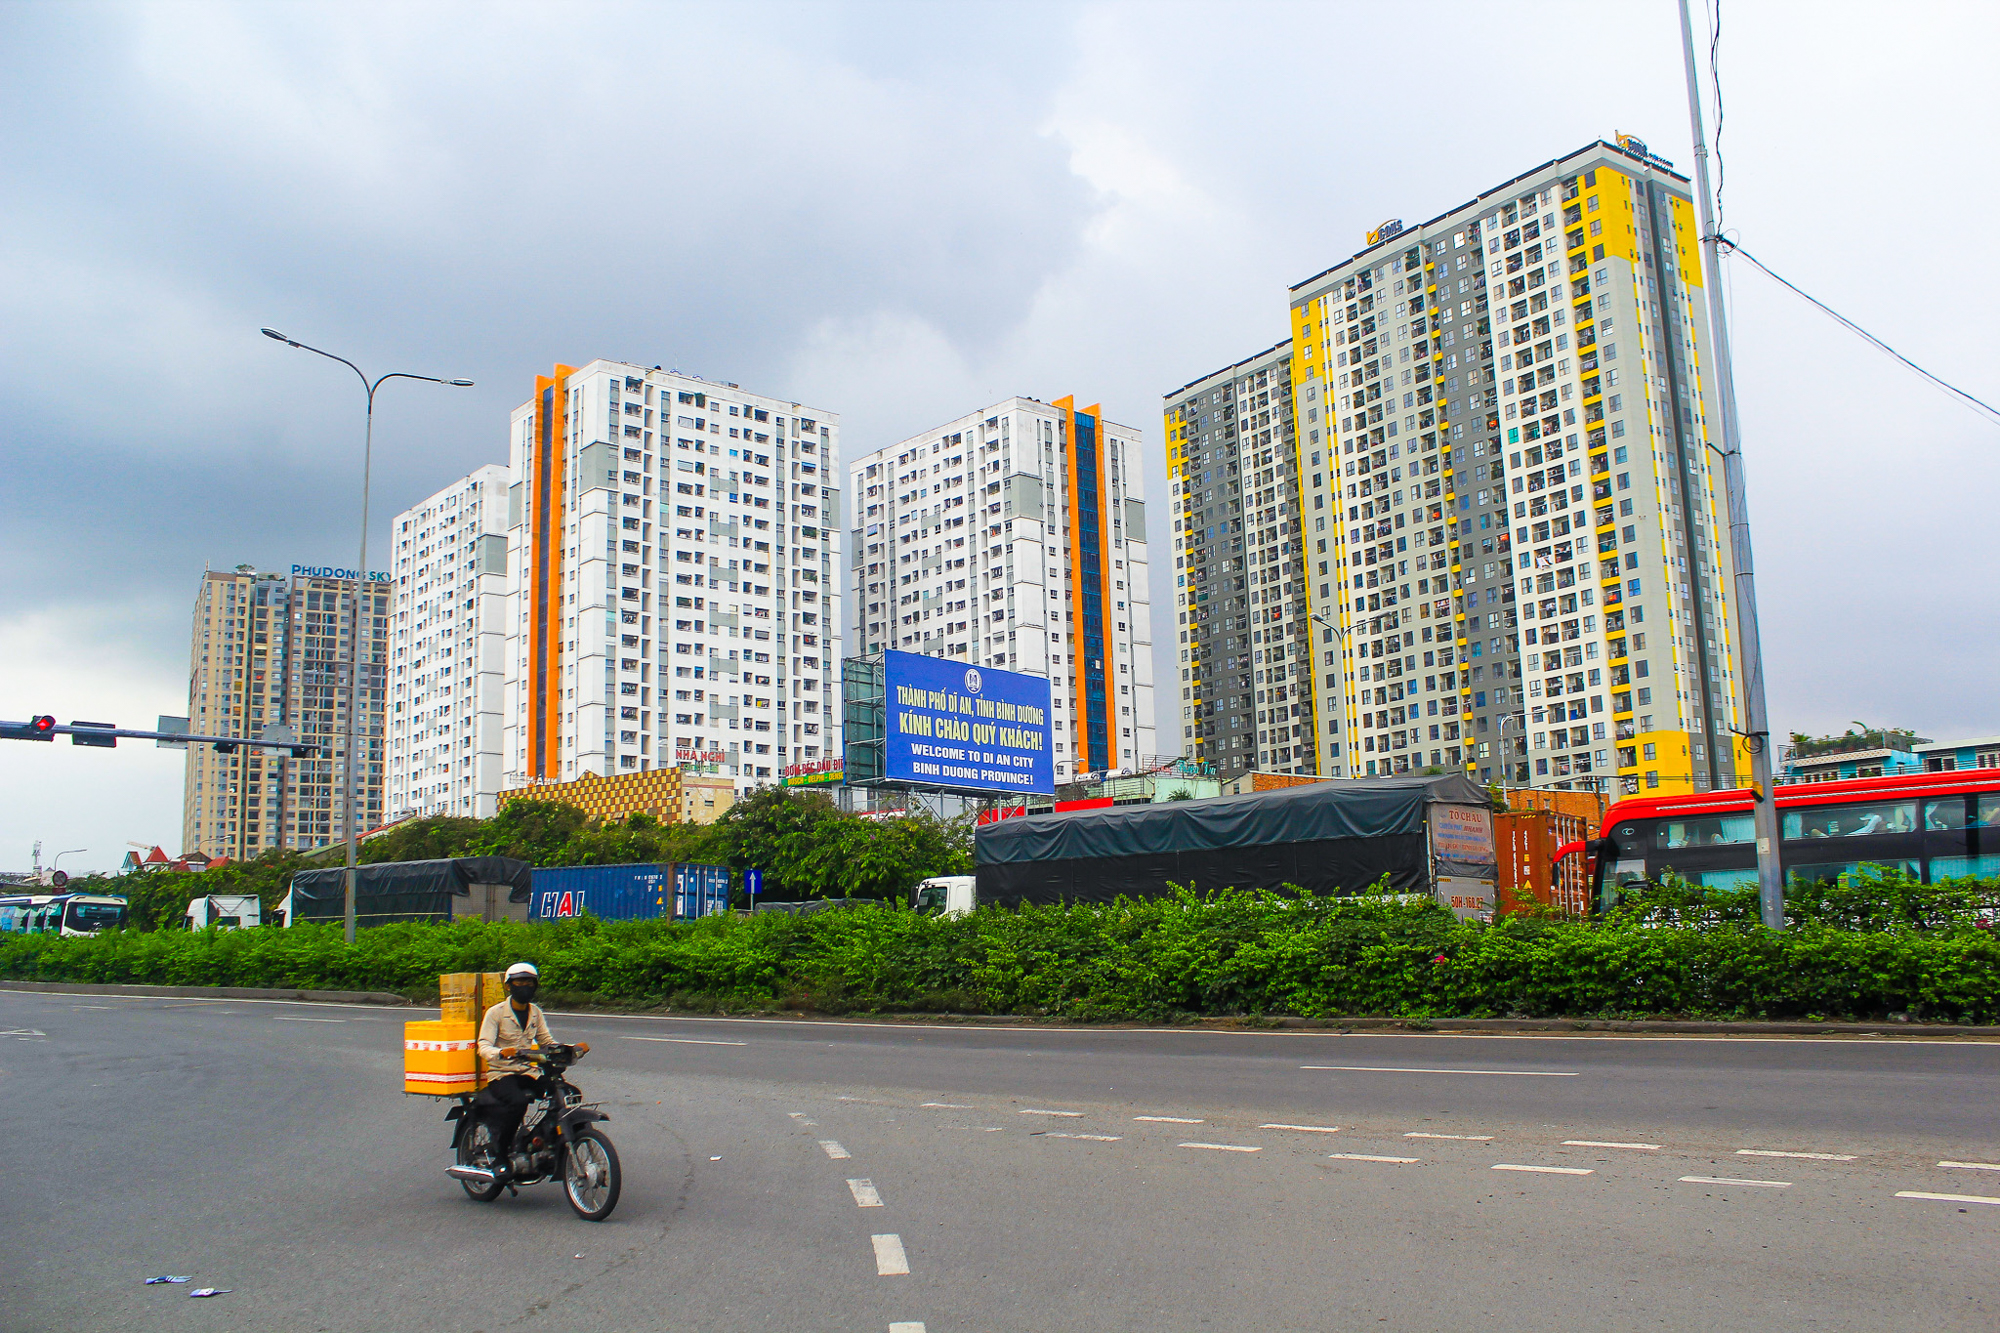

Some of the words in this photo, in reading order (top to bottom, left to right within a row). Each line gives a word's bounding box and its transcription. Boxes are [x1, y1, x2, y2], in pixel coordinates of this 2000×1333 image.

[896, 683, 927, 709] THÀNH
[928, 687, 947, 711] PHỐ
[948, 691, 958, 713] DĨ
[959, 696, 975, 718] AN,
[975, 693, 995, 719] TỈNH
[996, 698, 1016, 722] BÌNH
[1017, 704, 1044, 726] DƯƠNG
[899, 709, 932, 737] KÍNH
[935, 715, 970, 742] CHÀO
[972, 721, 996, 746] QUÝ
[999, 725, 1043, 751] KHÁCH!
[675, 746, 698, 761] NHÀ
[910, 743, 966, 761] WELCOME
[967, 750, 981, 763] TO
[983, 752, 994, 764] DI
[996, 754, 1011, 766] AN
[1013, 756, 1034, 768] CITY
[912, 762, 940, 775] BINH
[942, 765, 979, 780] DUONG
[981, 769, 1034, 785] PROVINCE!
[540, 890, 586, 918] HAI
